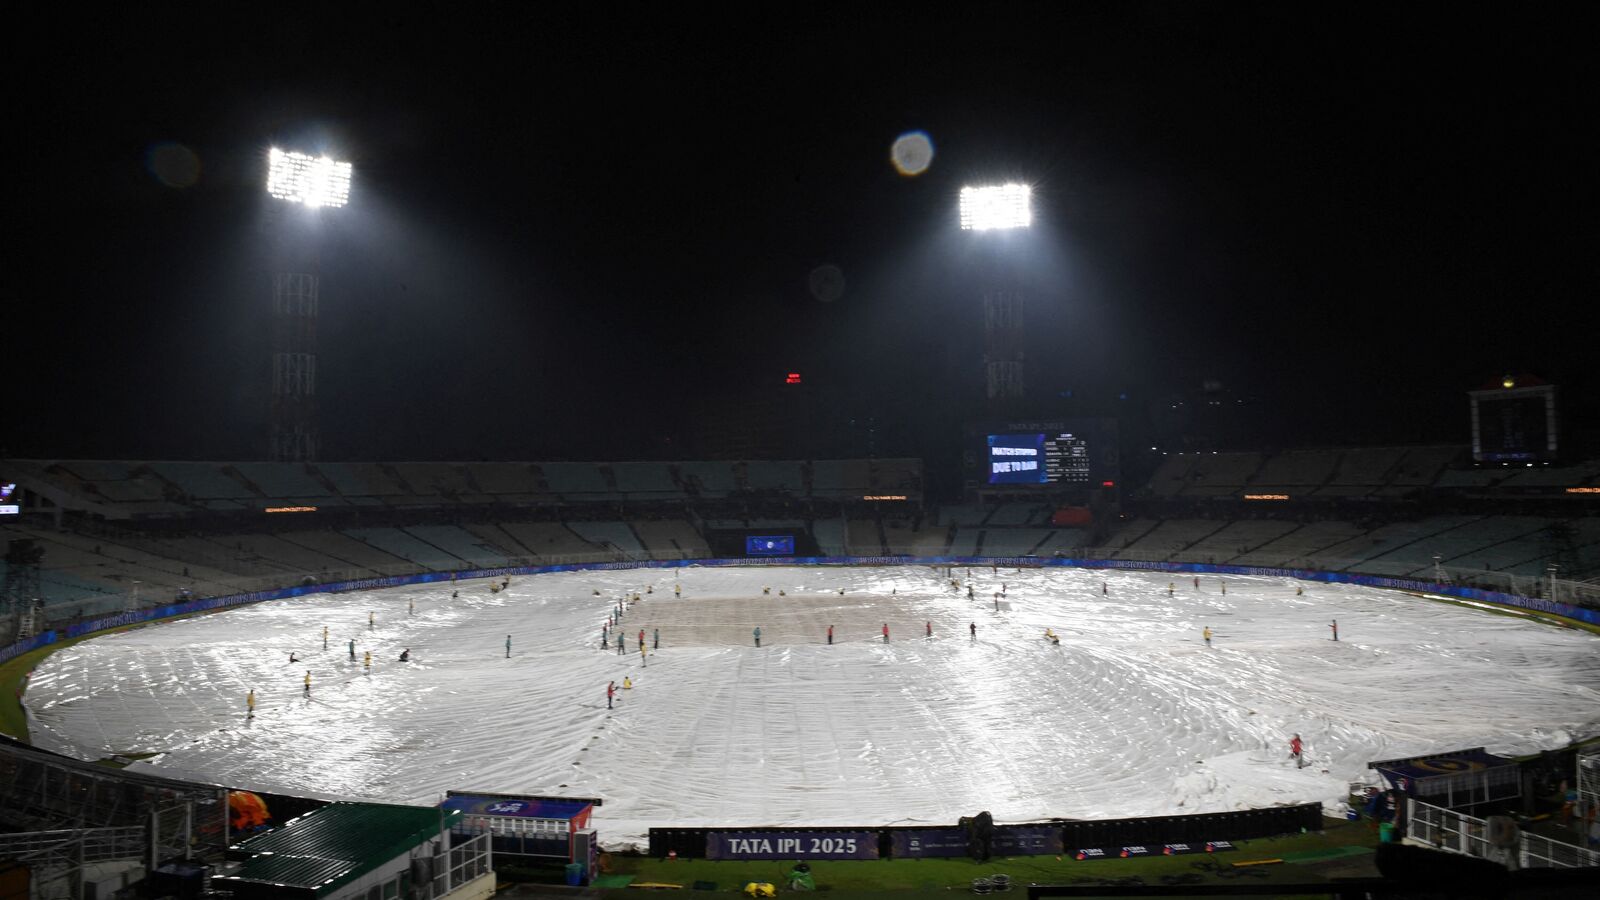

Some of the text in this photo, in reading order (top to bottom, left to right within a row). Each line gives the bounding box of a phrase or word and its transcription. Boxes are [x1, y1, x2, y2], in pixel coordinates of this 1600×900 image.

[993, 462, 1011, 473] DUE
[1011, 462, 1021, 471] TO
[728, 838, 857, 854] TATA IPL 2025
